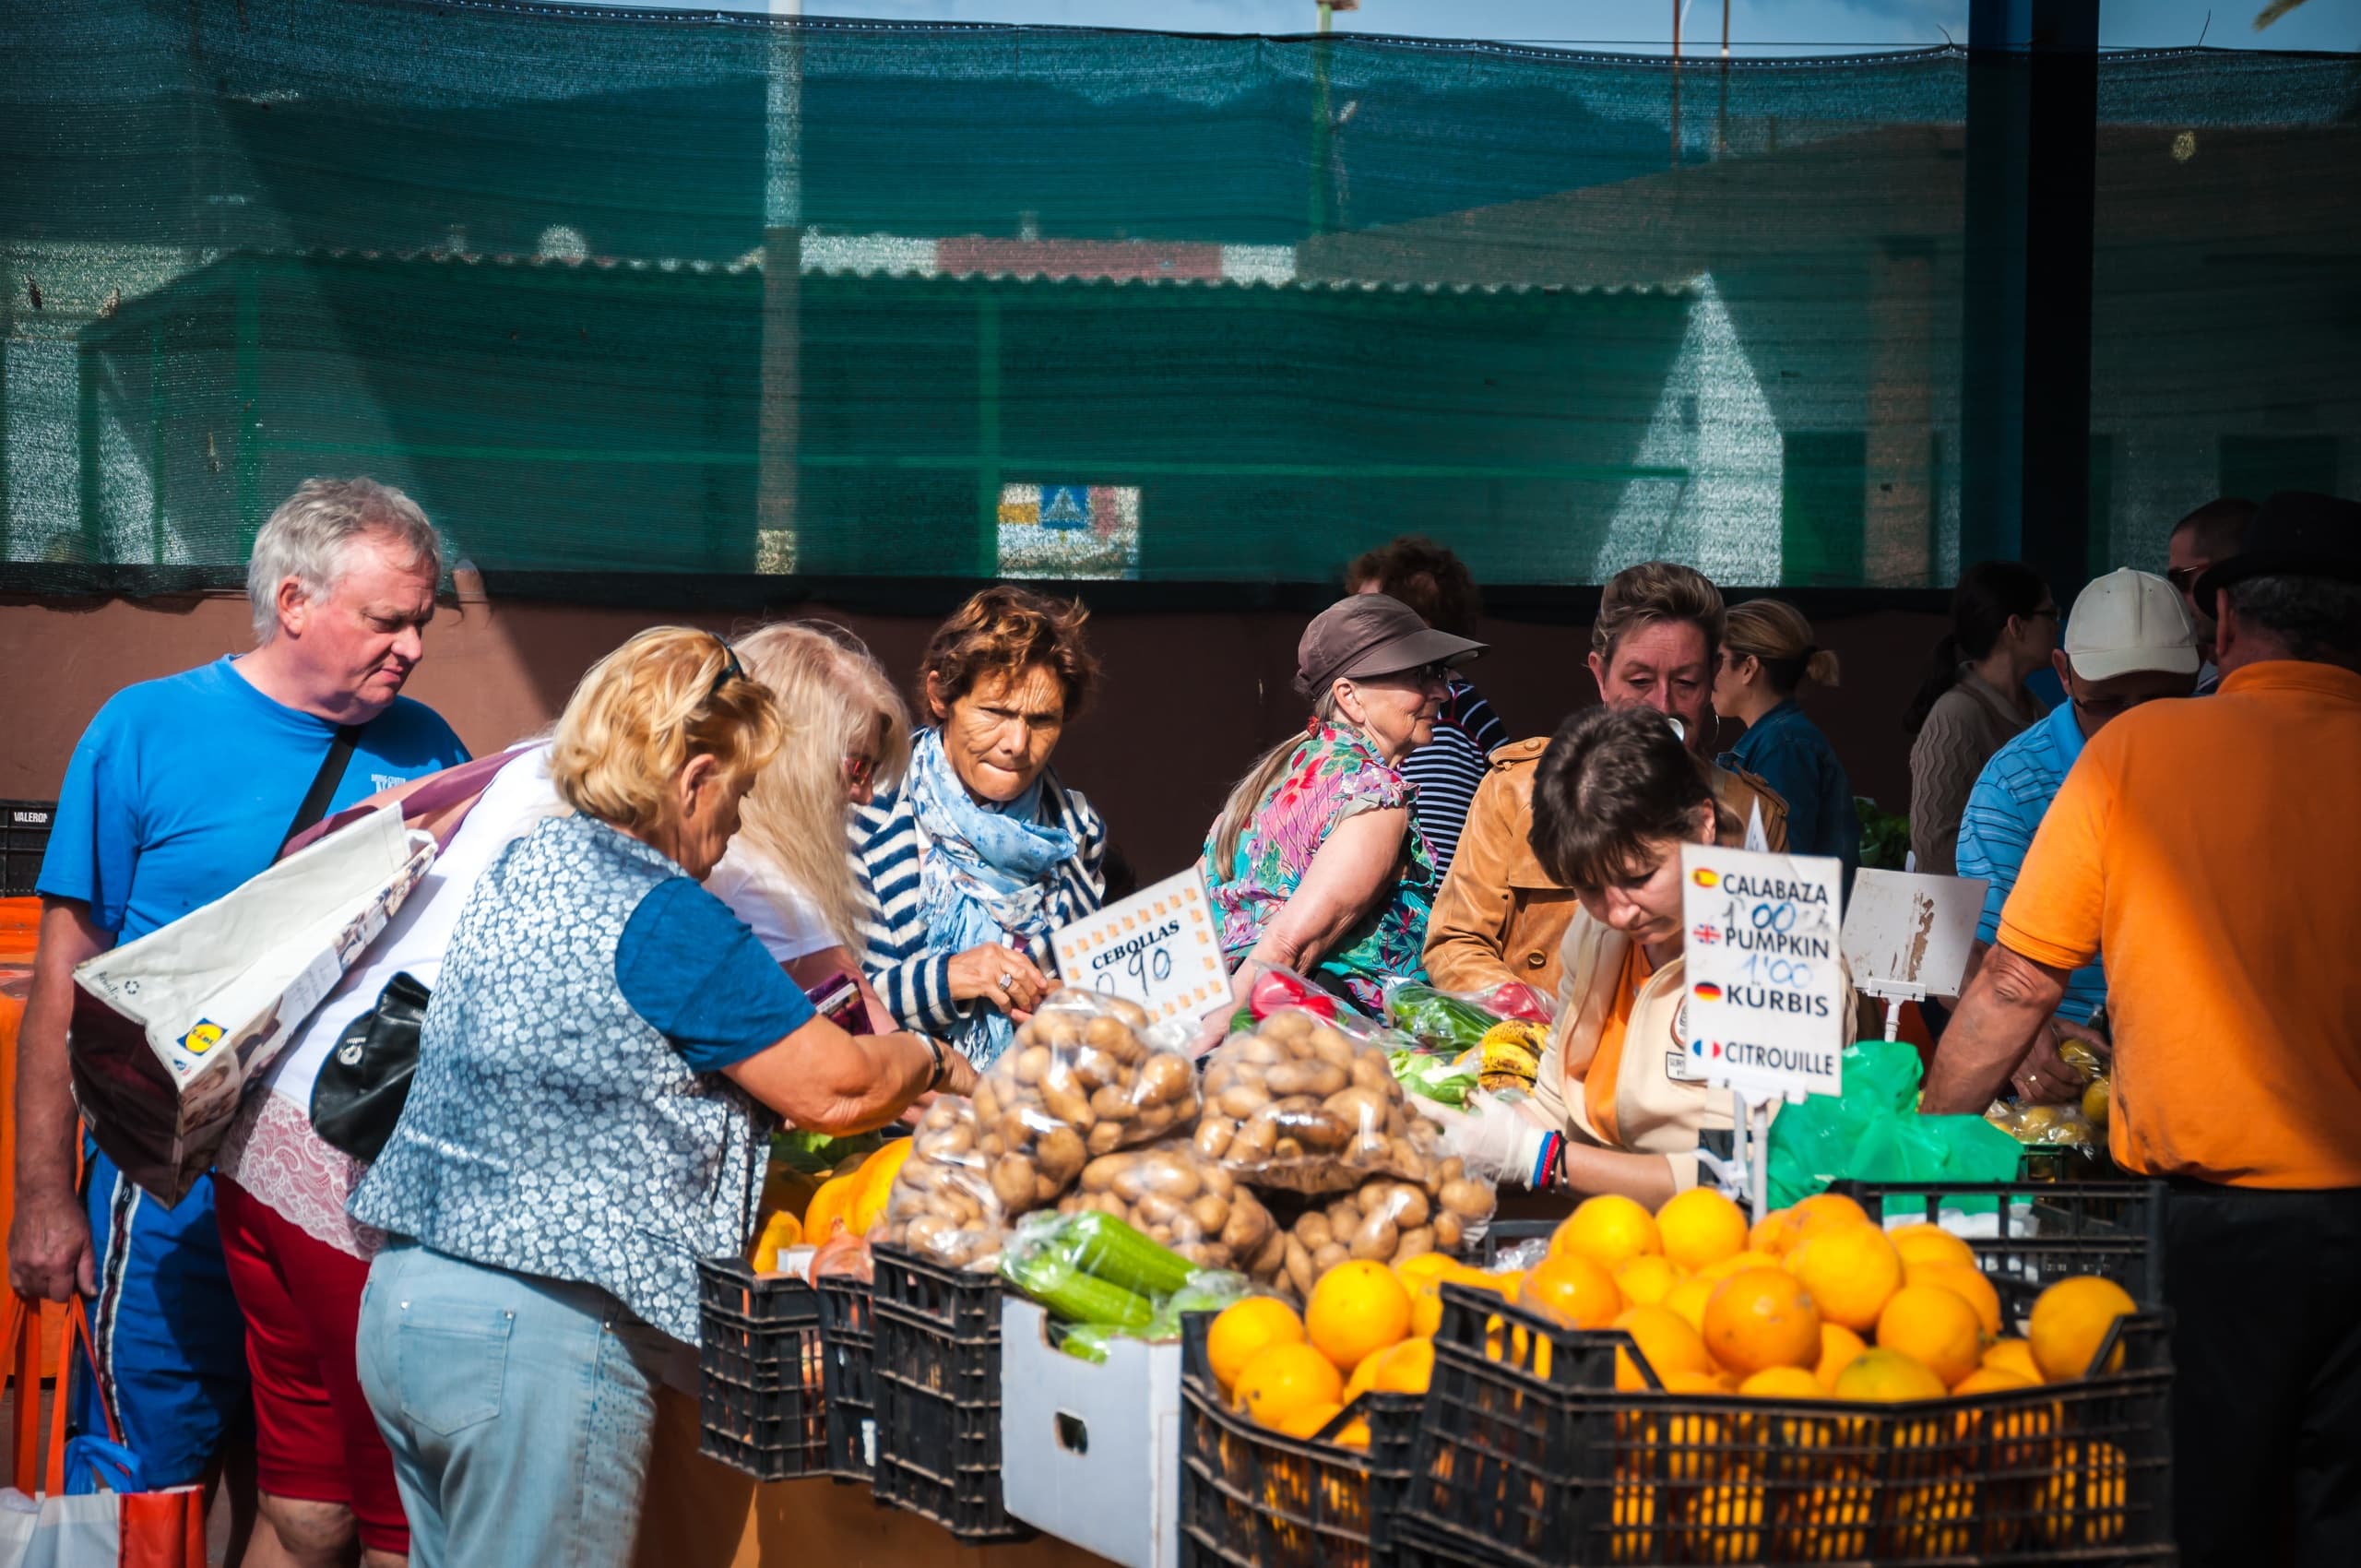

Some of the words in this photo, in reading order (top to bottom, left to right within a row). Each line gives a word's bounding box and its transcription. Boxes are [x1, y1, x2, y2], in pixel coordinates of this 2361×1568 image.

[1722, 873, 1829, 906] CALABAZA
[1092, 919, 1180, 970] CEBOLLAS
[1726, 927, 1829, 960] PUMPKIN
[1726, 981, 1829, 1016] KÜRBIS
[1726, 1041, 1834, 1075] CITROUILLE
